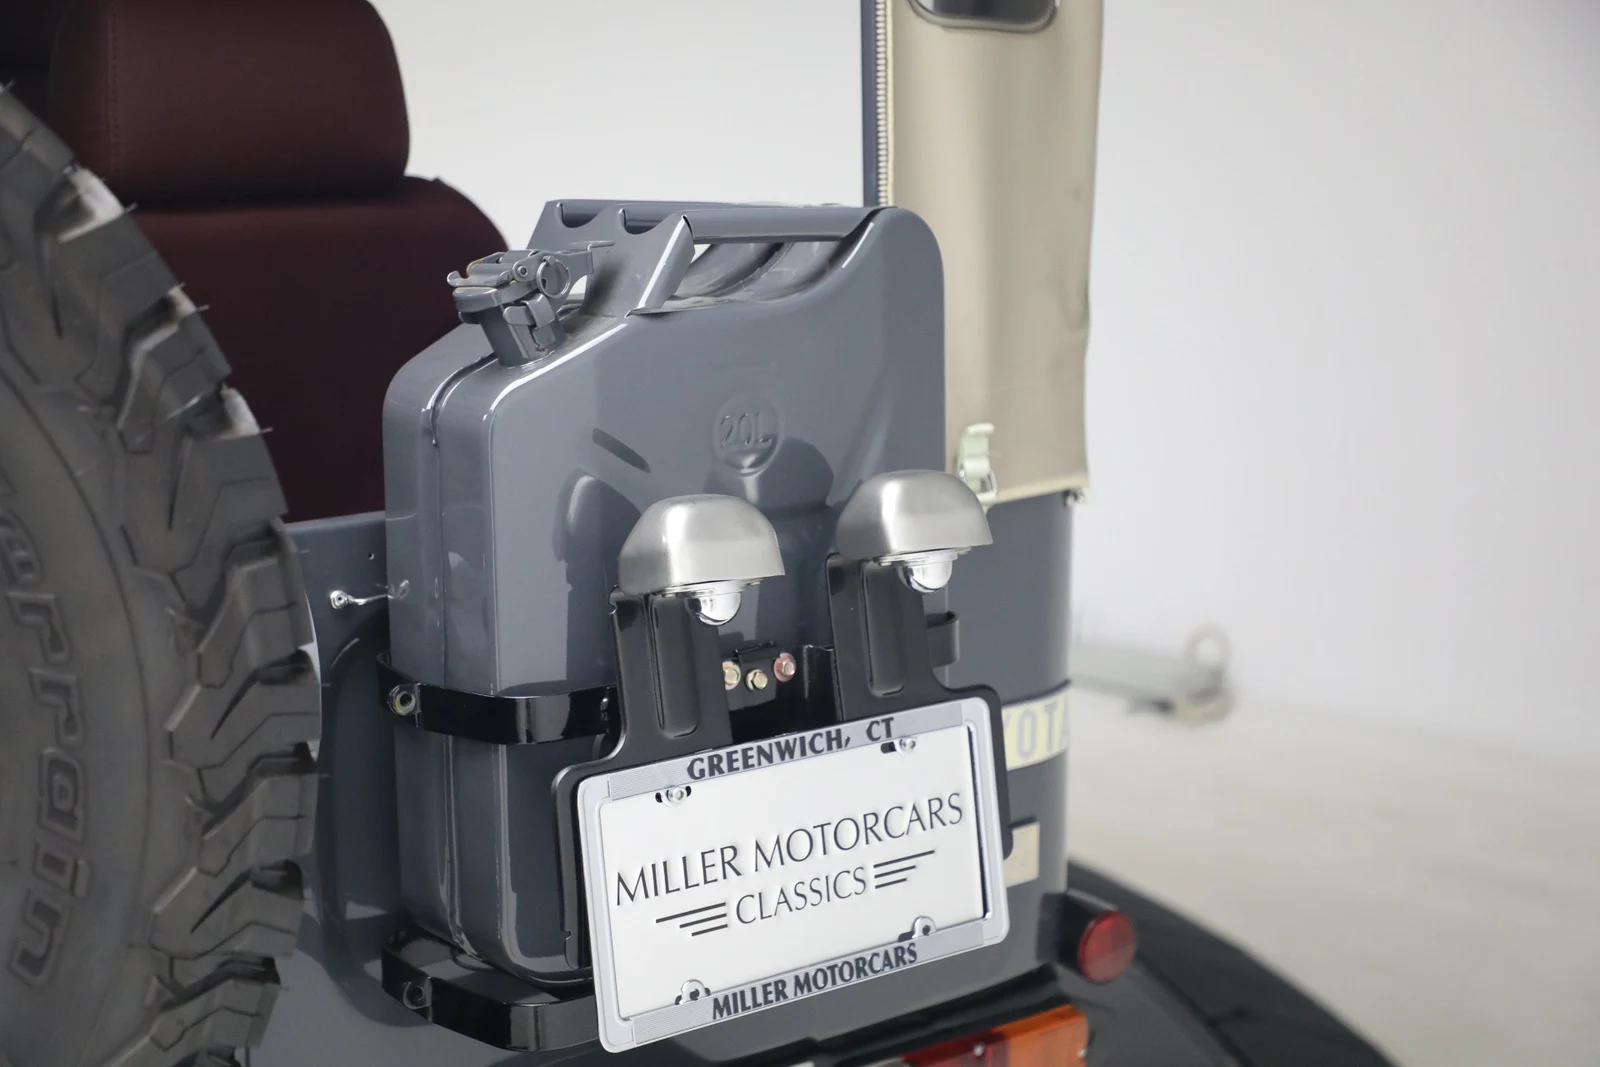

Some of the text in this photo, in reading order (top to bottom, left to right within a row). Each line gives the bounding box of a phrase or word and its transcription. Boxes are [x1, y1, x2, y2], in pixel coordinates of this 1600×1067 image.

[720, 411, 773, 449] 20L
[0, 475, 90, 988] errain
[687, 716, 896, 780] GREENWICH, CT
[616, 792, 964, 906] MILLER MOTORCARS
[735, 866, 867, 925] CLASSICS
[712, 943, 918, 1021] MILLER MOTORCARS
